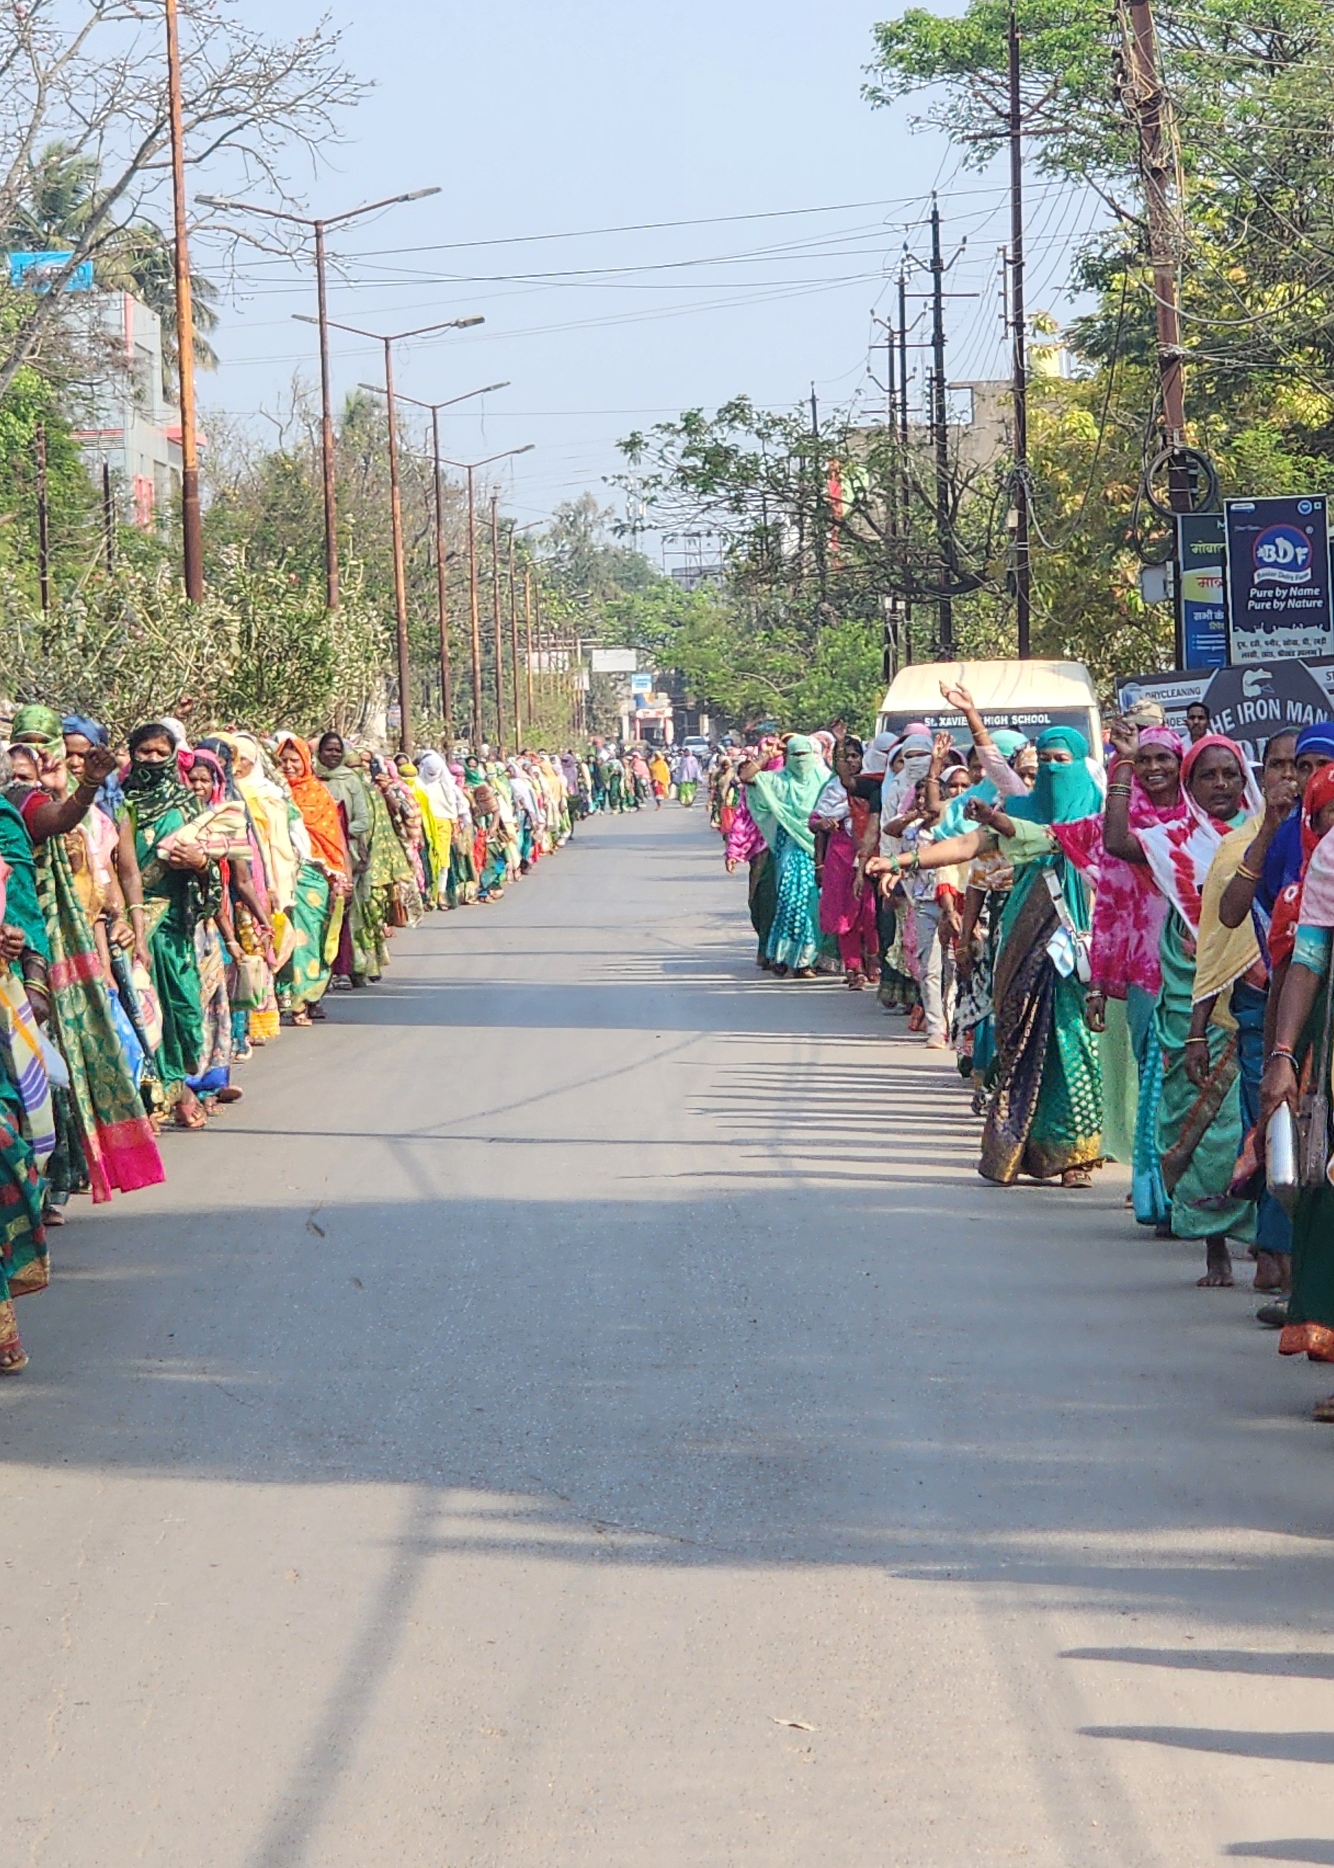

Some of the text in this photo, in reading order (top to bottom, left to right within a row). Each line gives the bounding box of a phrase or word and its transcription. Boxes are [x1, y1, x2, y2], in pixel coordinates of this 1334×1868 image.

[1261, 536, 1309, 566] BDF
[1250, 586, 1320, 599] Pure by Name
[1248, 598, 1324, 611] Pure by Nature
[984, 715, 1008, 725] HIGH
[1011, 713, 1051, 724] SCHOOL
[1210, 699, 1328, 734] HE IRON MAN
